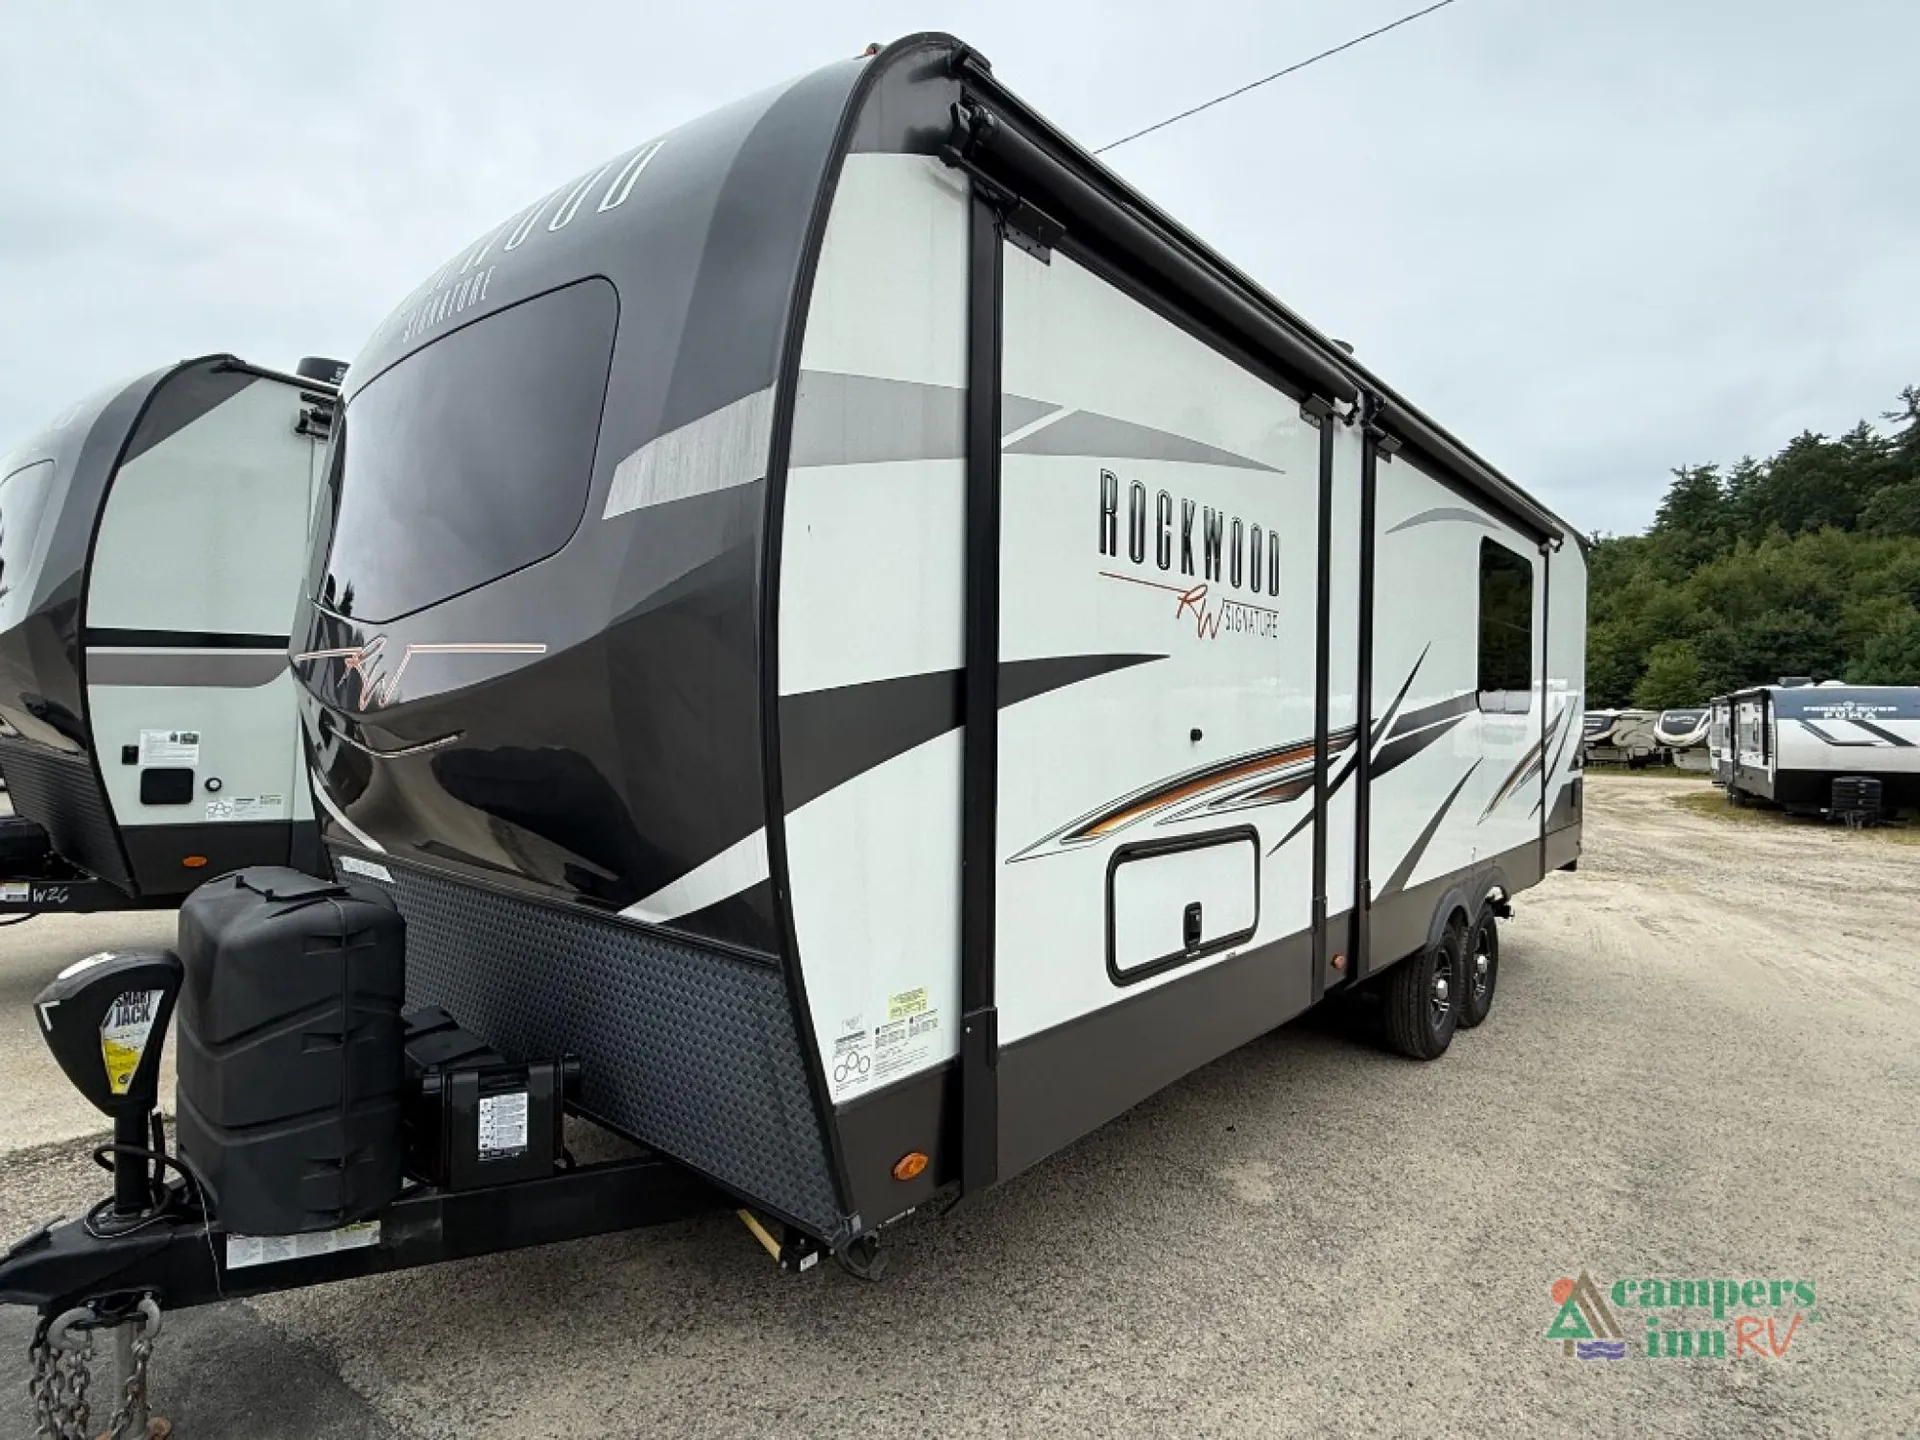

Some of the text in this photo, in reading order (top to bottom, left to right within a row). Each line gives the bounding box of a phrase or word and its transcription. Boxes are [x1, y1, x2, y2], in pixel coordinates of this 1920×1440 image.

[403, 266, 495, 342] SIGNATURE
[1099, 468, 1280, 597] ROCKWOOD
[1225, 604, 1278, 639] SIGNATURE
[114, 1003, 151, 1028] JACK
